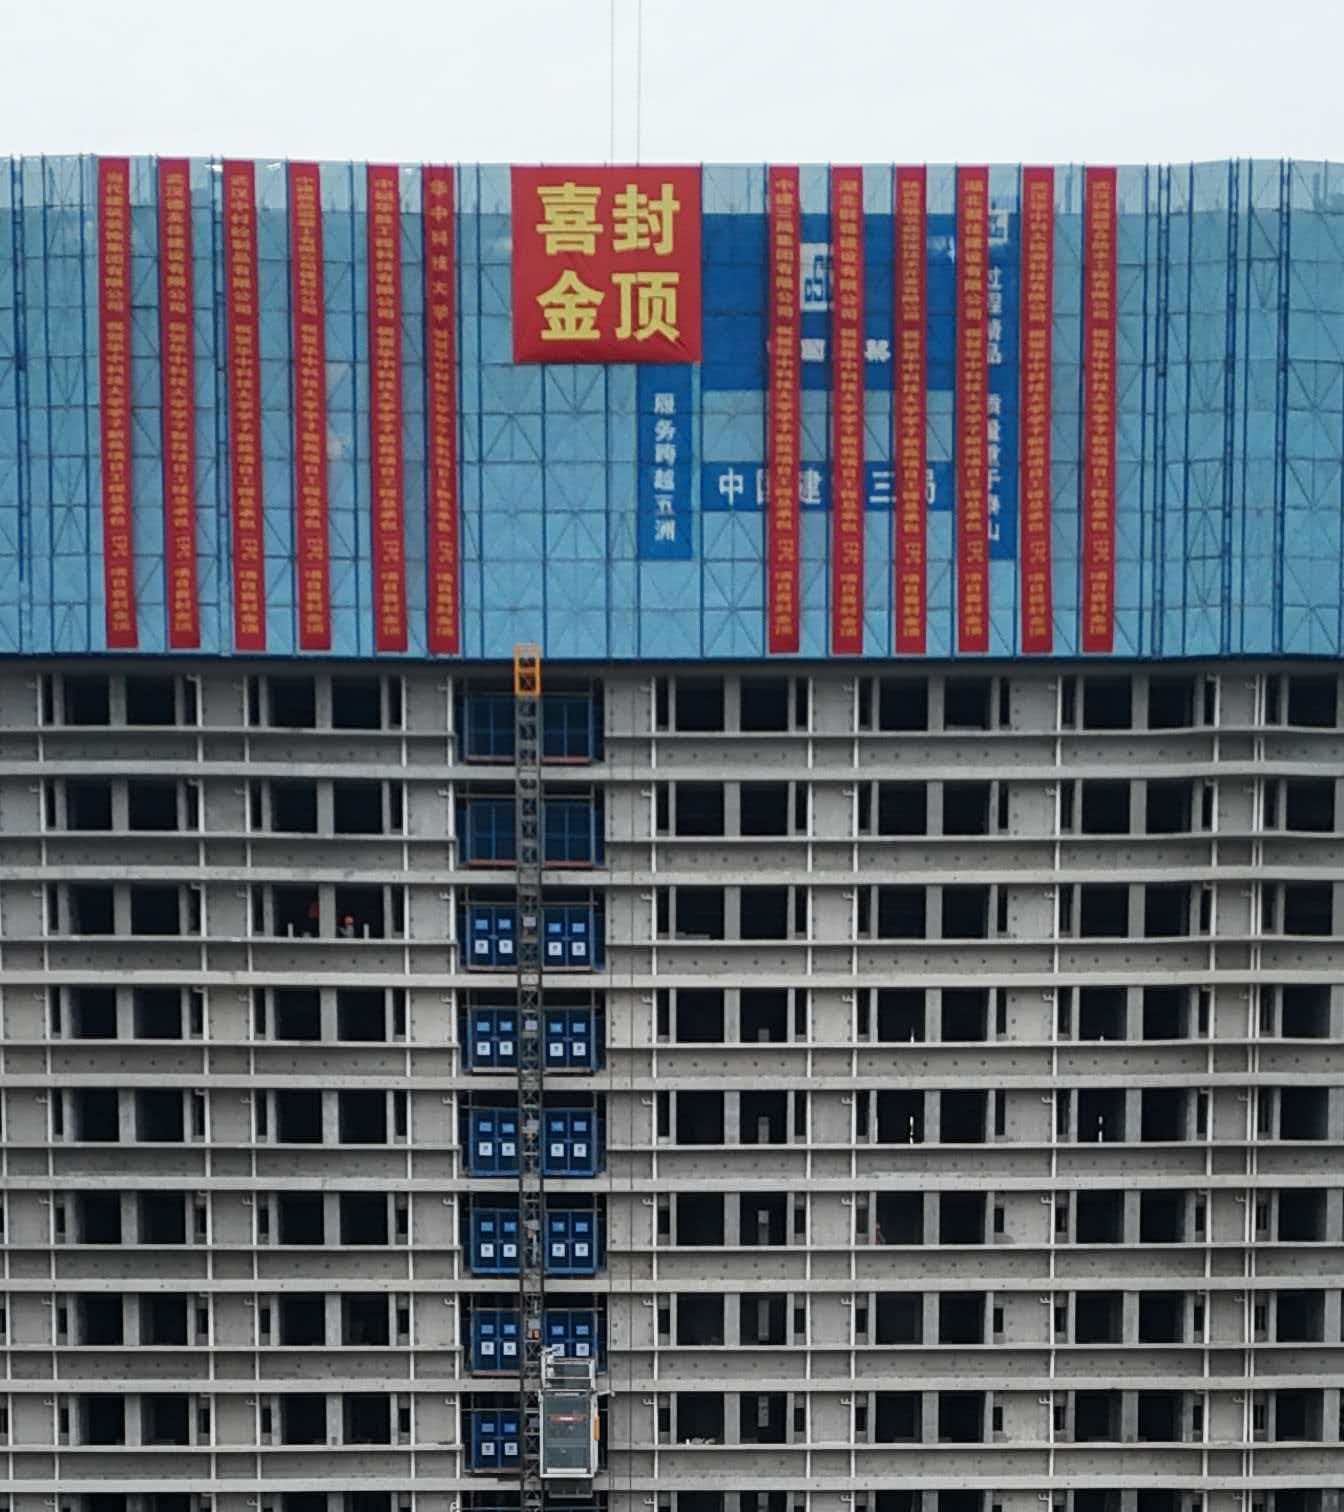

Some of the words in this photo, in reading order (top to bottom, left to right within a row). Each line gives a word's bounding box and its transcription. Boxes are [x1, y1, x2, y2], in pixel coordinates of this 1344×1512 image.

[535, 182, 682, 256] 喜封
[536, 269, 682, 344] 金顶
[653, 392, 677, 542] 服务跨越五洲
